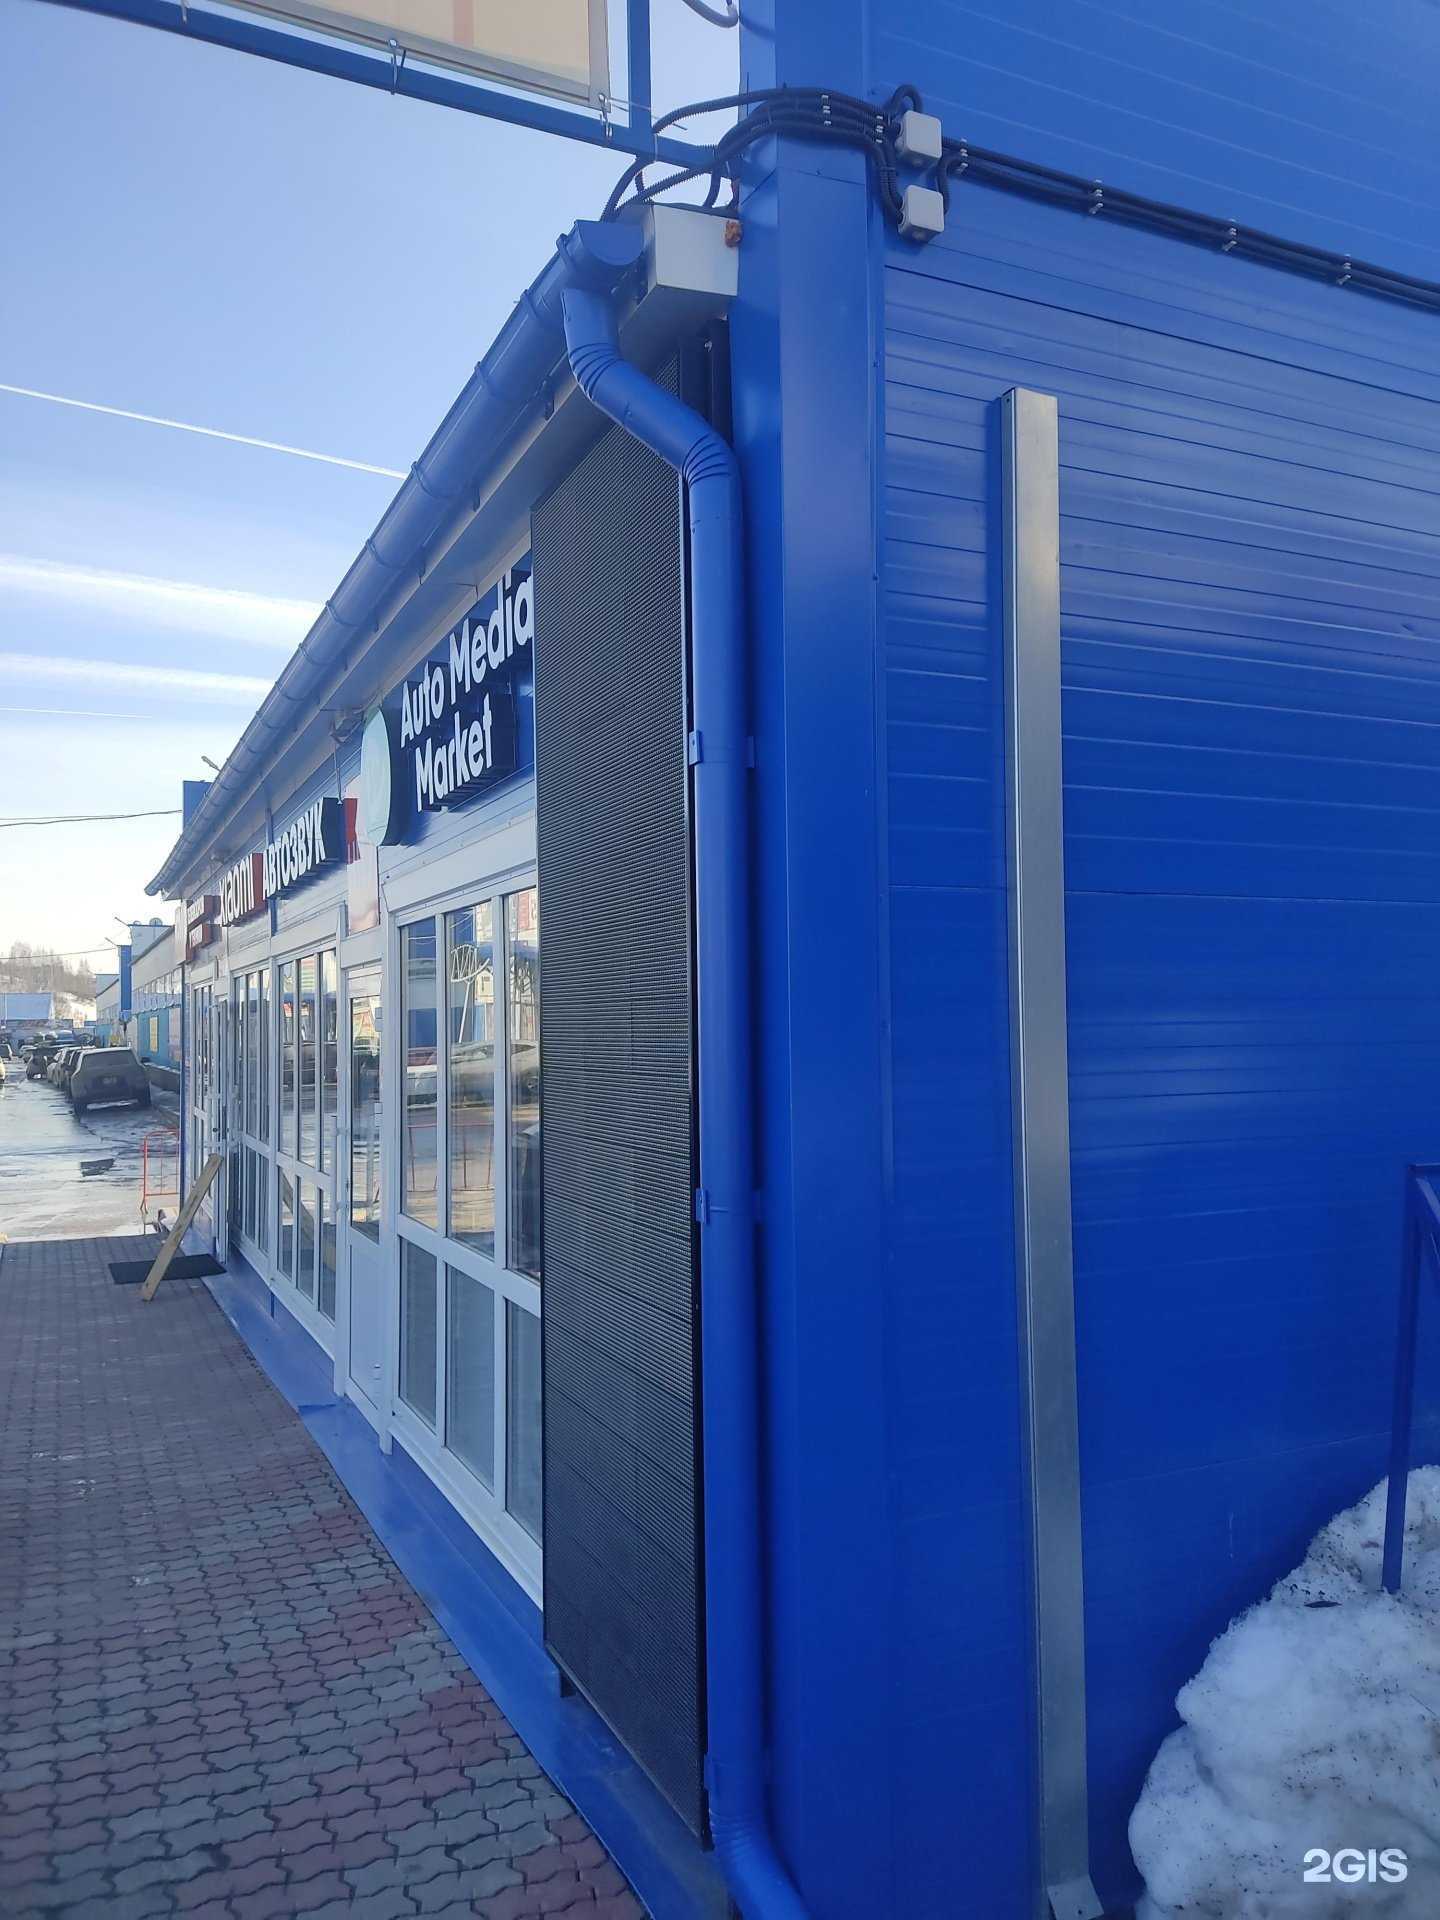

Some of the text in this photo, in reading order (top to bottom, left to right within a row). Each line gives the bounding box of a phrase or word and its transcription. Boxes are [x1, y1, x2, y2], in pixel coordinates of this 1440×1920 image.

[401, 568, 534, 748] Auto Media
[415, 692, 492, 813] Market
[263, 797, 326, 900] АВТОЗВУК
